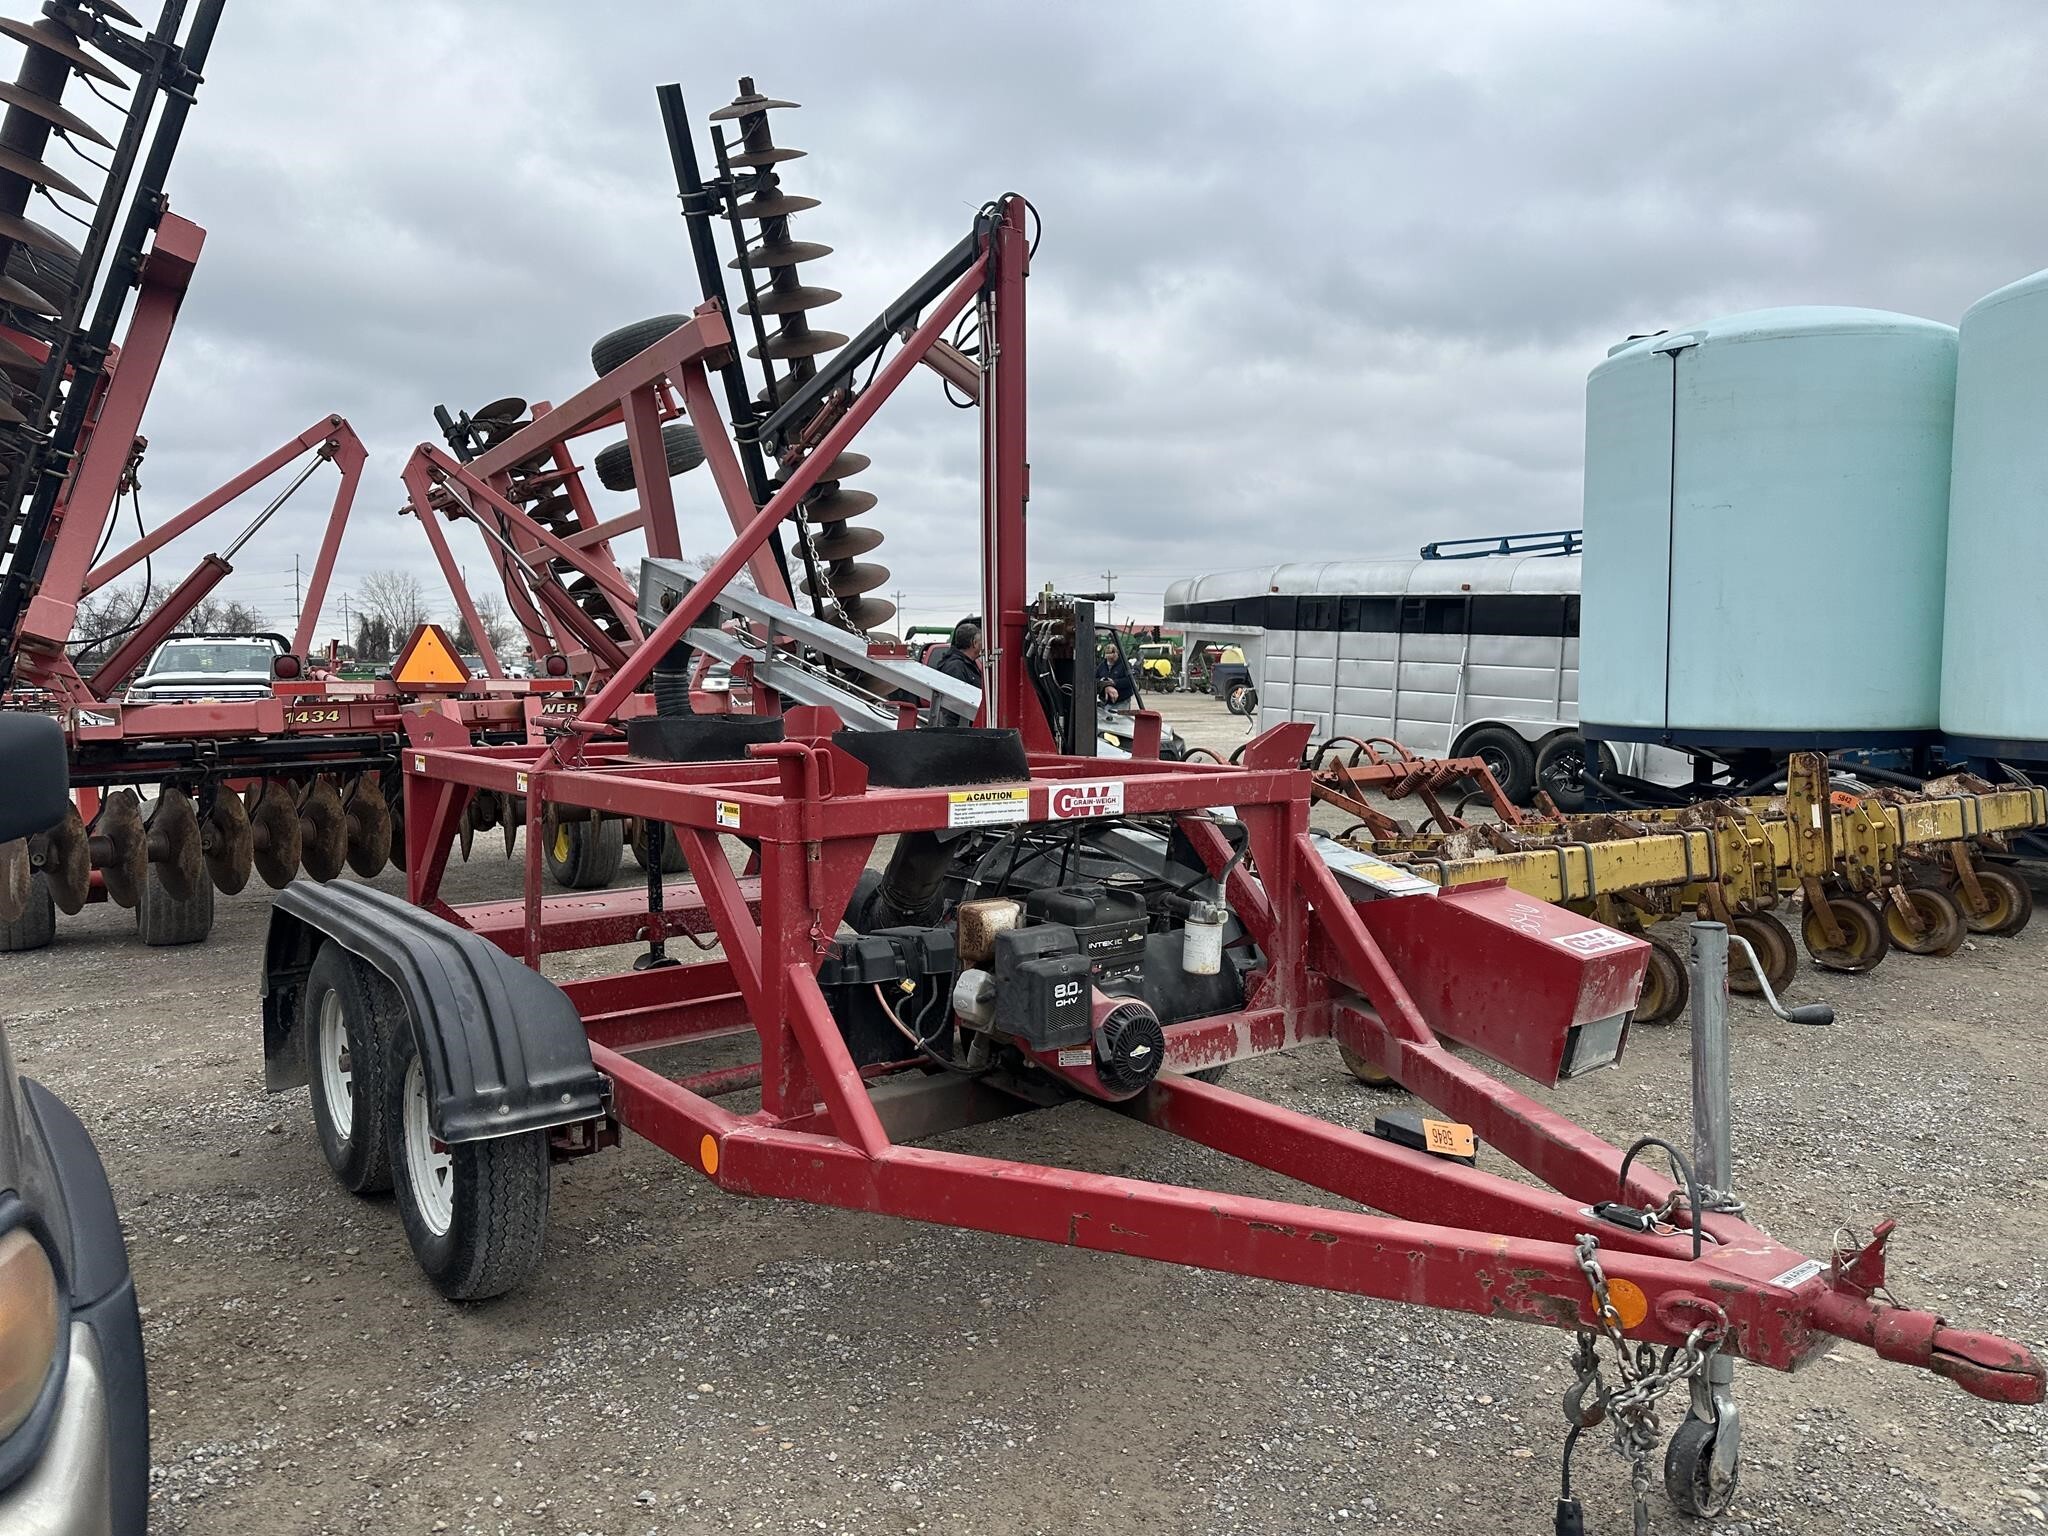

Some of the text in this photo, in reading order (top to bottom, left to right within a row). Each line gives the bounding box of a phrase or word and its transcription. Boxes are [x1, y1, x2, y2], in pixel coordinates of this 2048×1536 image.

[285, 710, 340, 724] 1434
[973, 791, 1012, 801] CAUTION
[1837, 794, 1853, 805] 5842
[1073, 797, 1117, 806] GRAIN-WEIGH
[1917, 818, 1942, 837] 5842
[1089, 939, 1114, 949] INTEK
[1055, 997, 1078, 1007] OHV
[1431, 1128, 1454, 1146] 5846
